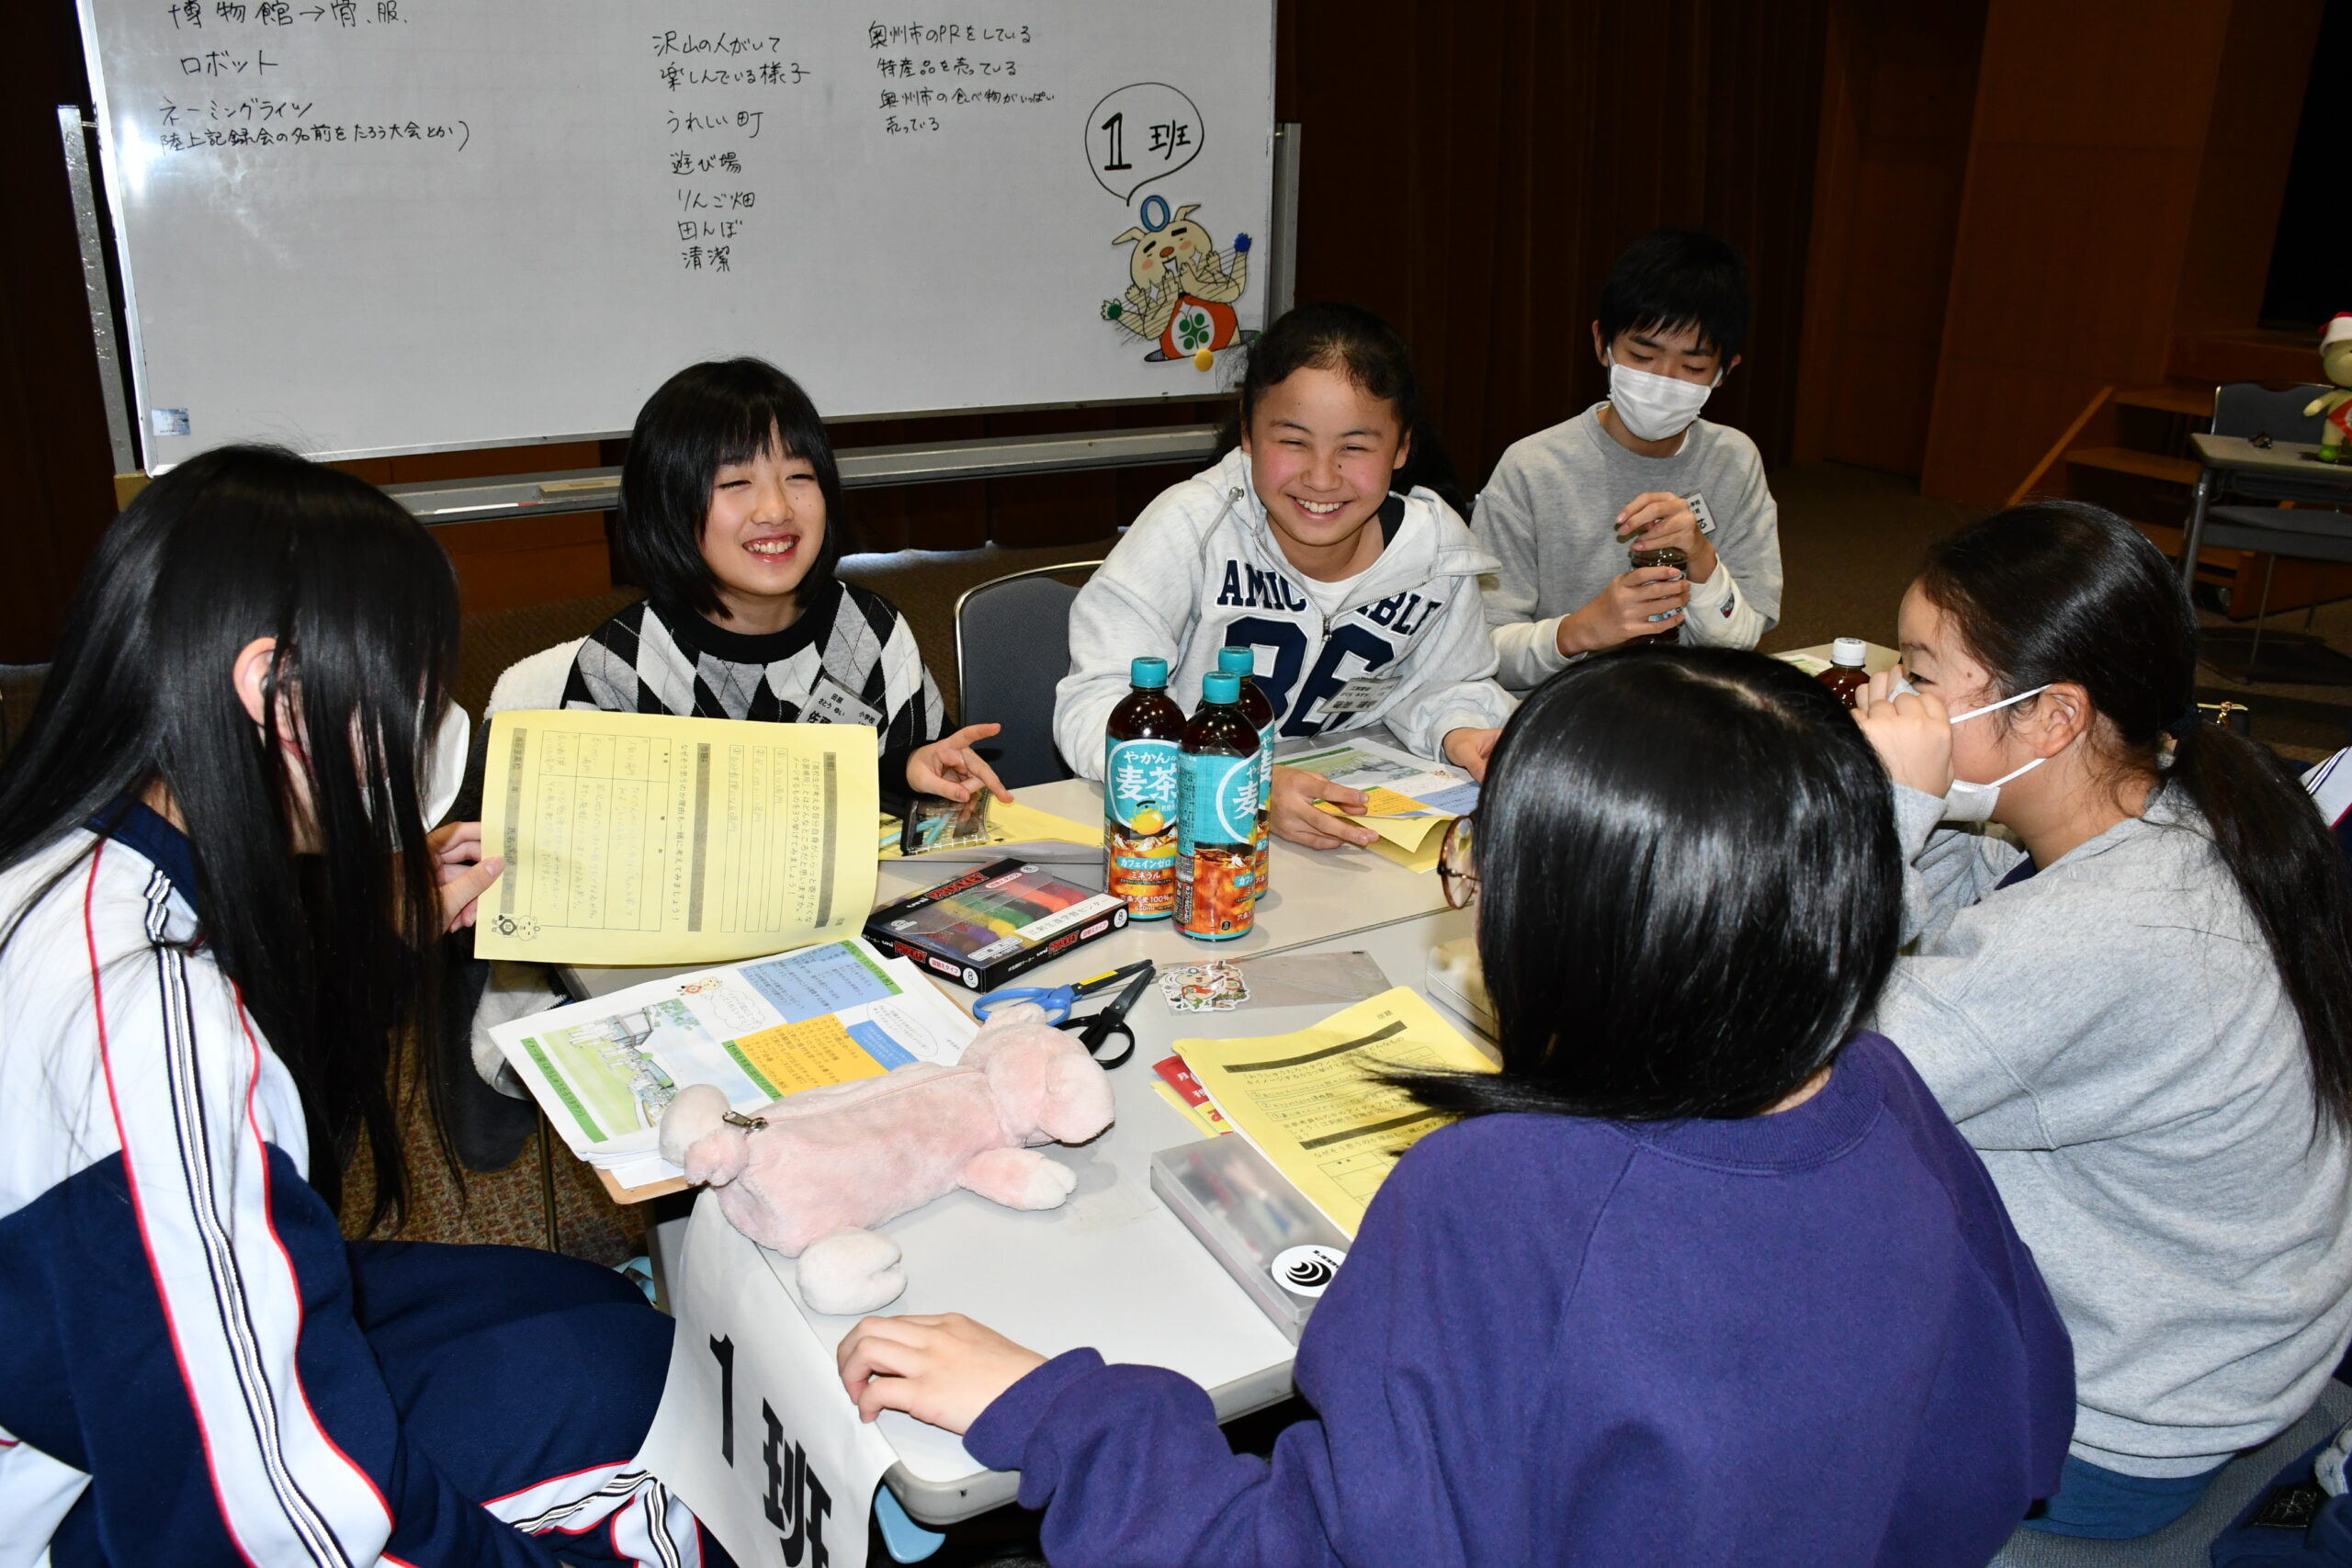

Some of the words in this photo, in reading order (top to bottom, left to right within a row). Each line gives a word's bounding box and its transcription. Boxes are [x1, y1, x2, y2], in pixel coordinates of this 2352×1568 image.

[180, 50, 279, 76] ロボット
[876, 58, 1017, 77] 特産品を売っている
[660, 61, 811, 92] 楽しんでいる様子
[159, 96, 314, 127] ネーミングライツ
[666, 109, 764, 139] うれしい町
[885, 116, 941, 134] 売っている
[670, 150, 741, 175] 遊び場
[678, 188, 755, 211] りんご畑
[677, 220, 743, 241] 田んぼ
[681, 245, 731, 273] 清潔
[1115, 763, 1178, 803] 麦茶
[1120, 858, 1171, 869] カフェインゼロ
